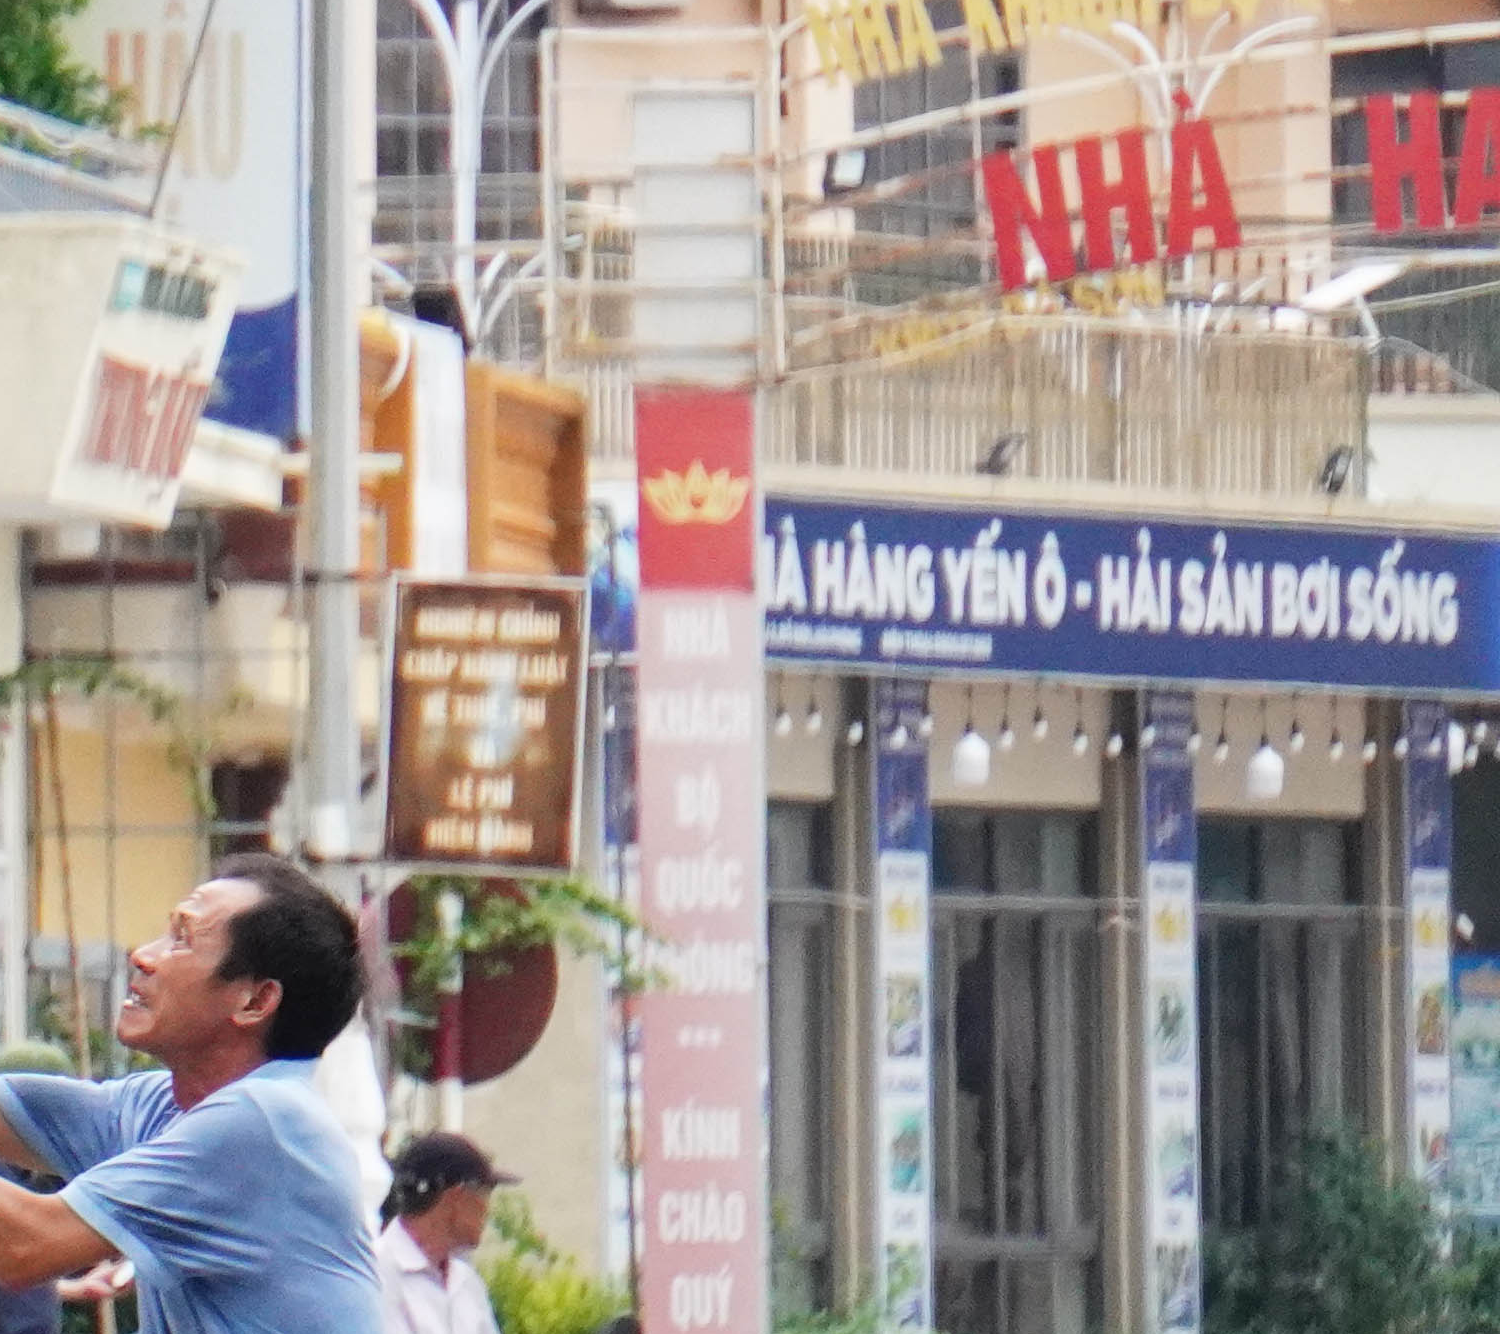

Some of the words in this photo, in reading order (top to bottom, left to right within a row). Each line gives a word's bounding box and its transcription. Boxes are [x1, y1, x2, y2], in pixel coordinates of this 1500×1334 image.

[979, 87, 1242, 294] NHÀ
[940, 518, 1026, 626] YẾN
[1099, 525, 1172, 634] HẢI
[1178, 529, 1263, 637] SẢN
[1346, 538, 1460, 645] SỐNG
[662, 597, 731, 659] NHÀ
[645, 679, 754, 741] KHÁCH
[660, 1095, 742, 1163] KÍNH
[658, 1179, 748, 1245] CHÀO
[670, 1262, 735, 1332] QUÝ
